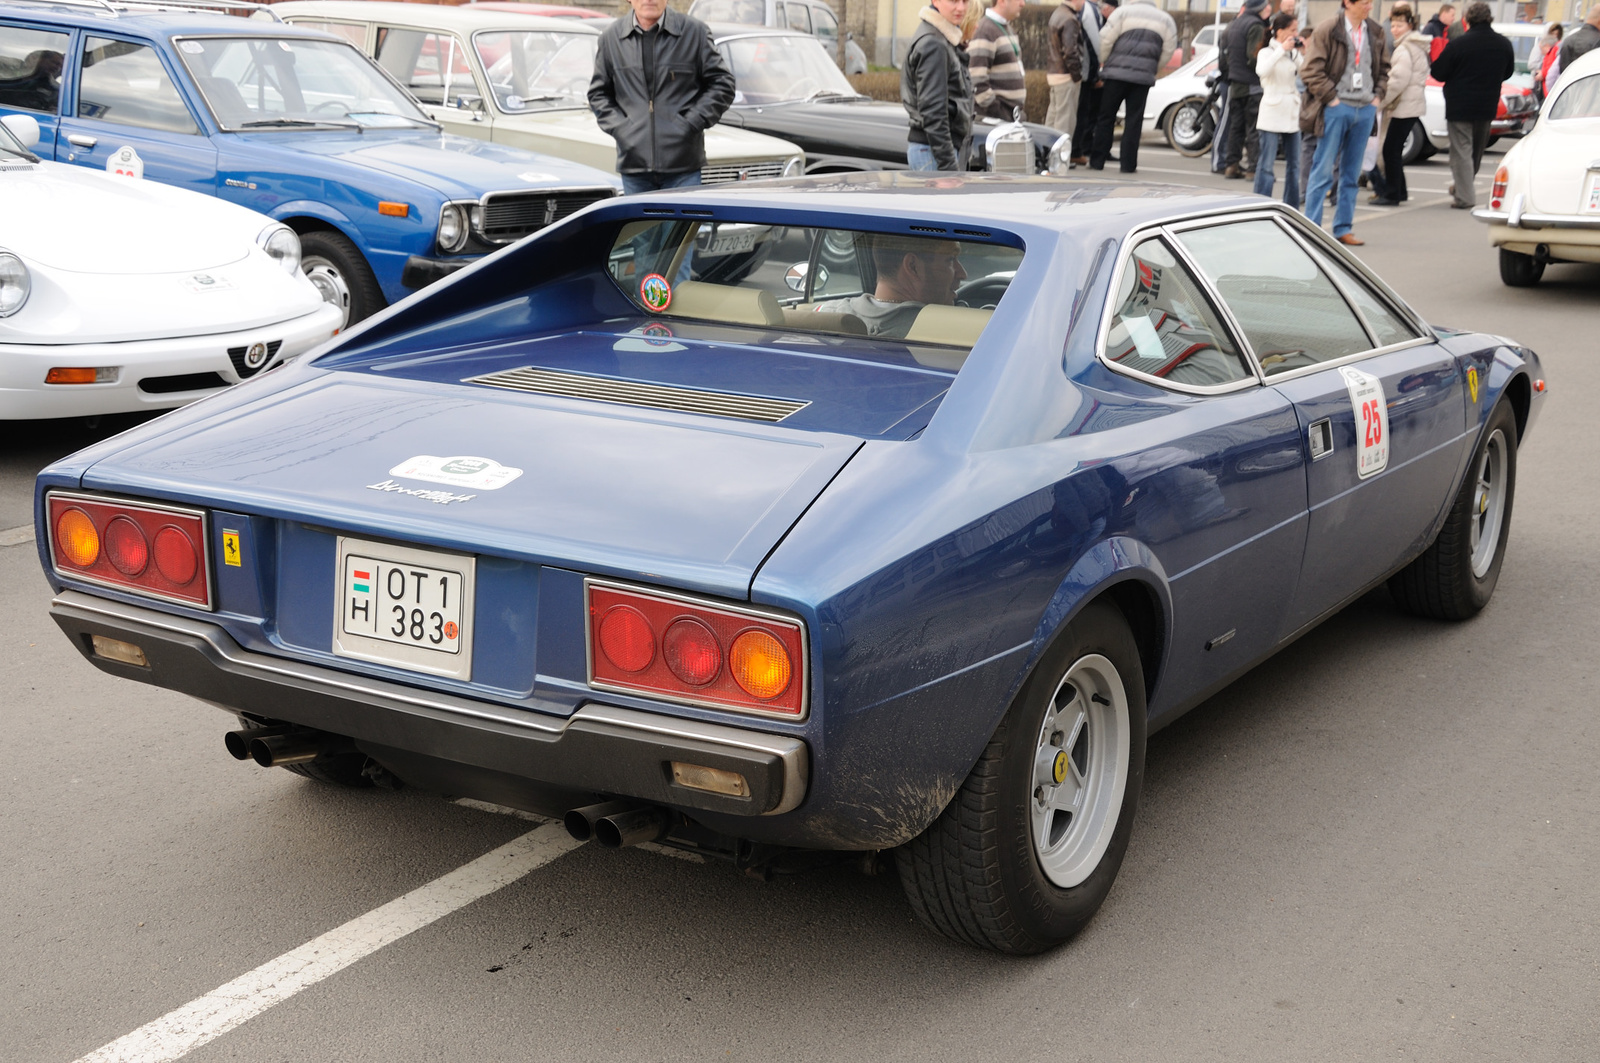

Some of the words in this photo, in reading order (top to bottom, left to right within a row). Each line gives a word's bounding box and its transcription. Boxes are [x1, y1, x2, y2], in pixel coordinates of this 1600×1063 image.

[1362, 399, 1382, 448] 25
[351, 597, 369, 622] H
[391, 604, 444, 645] 383
